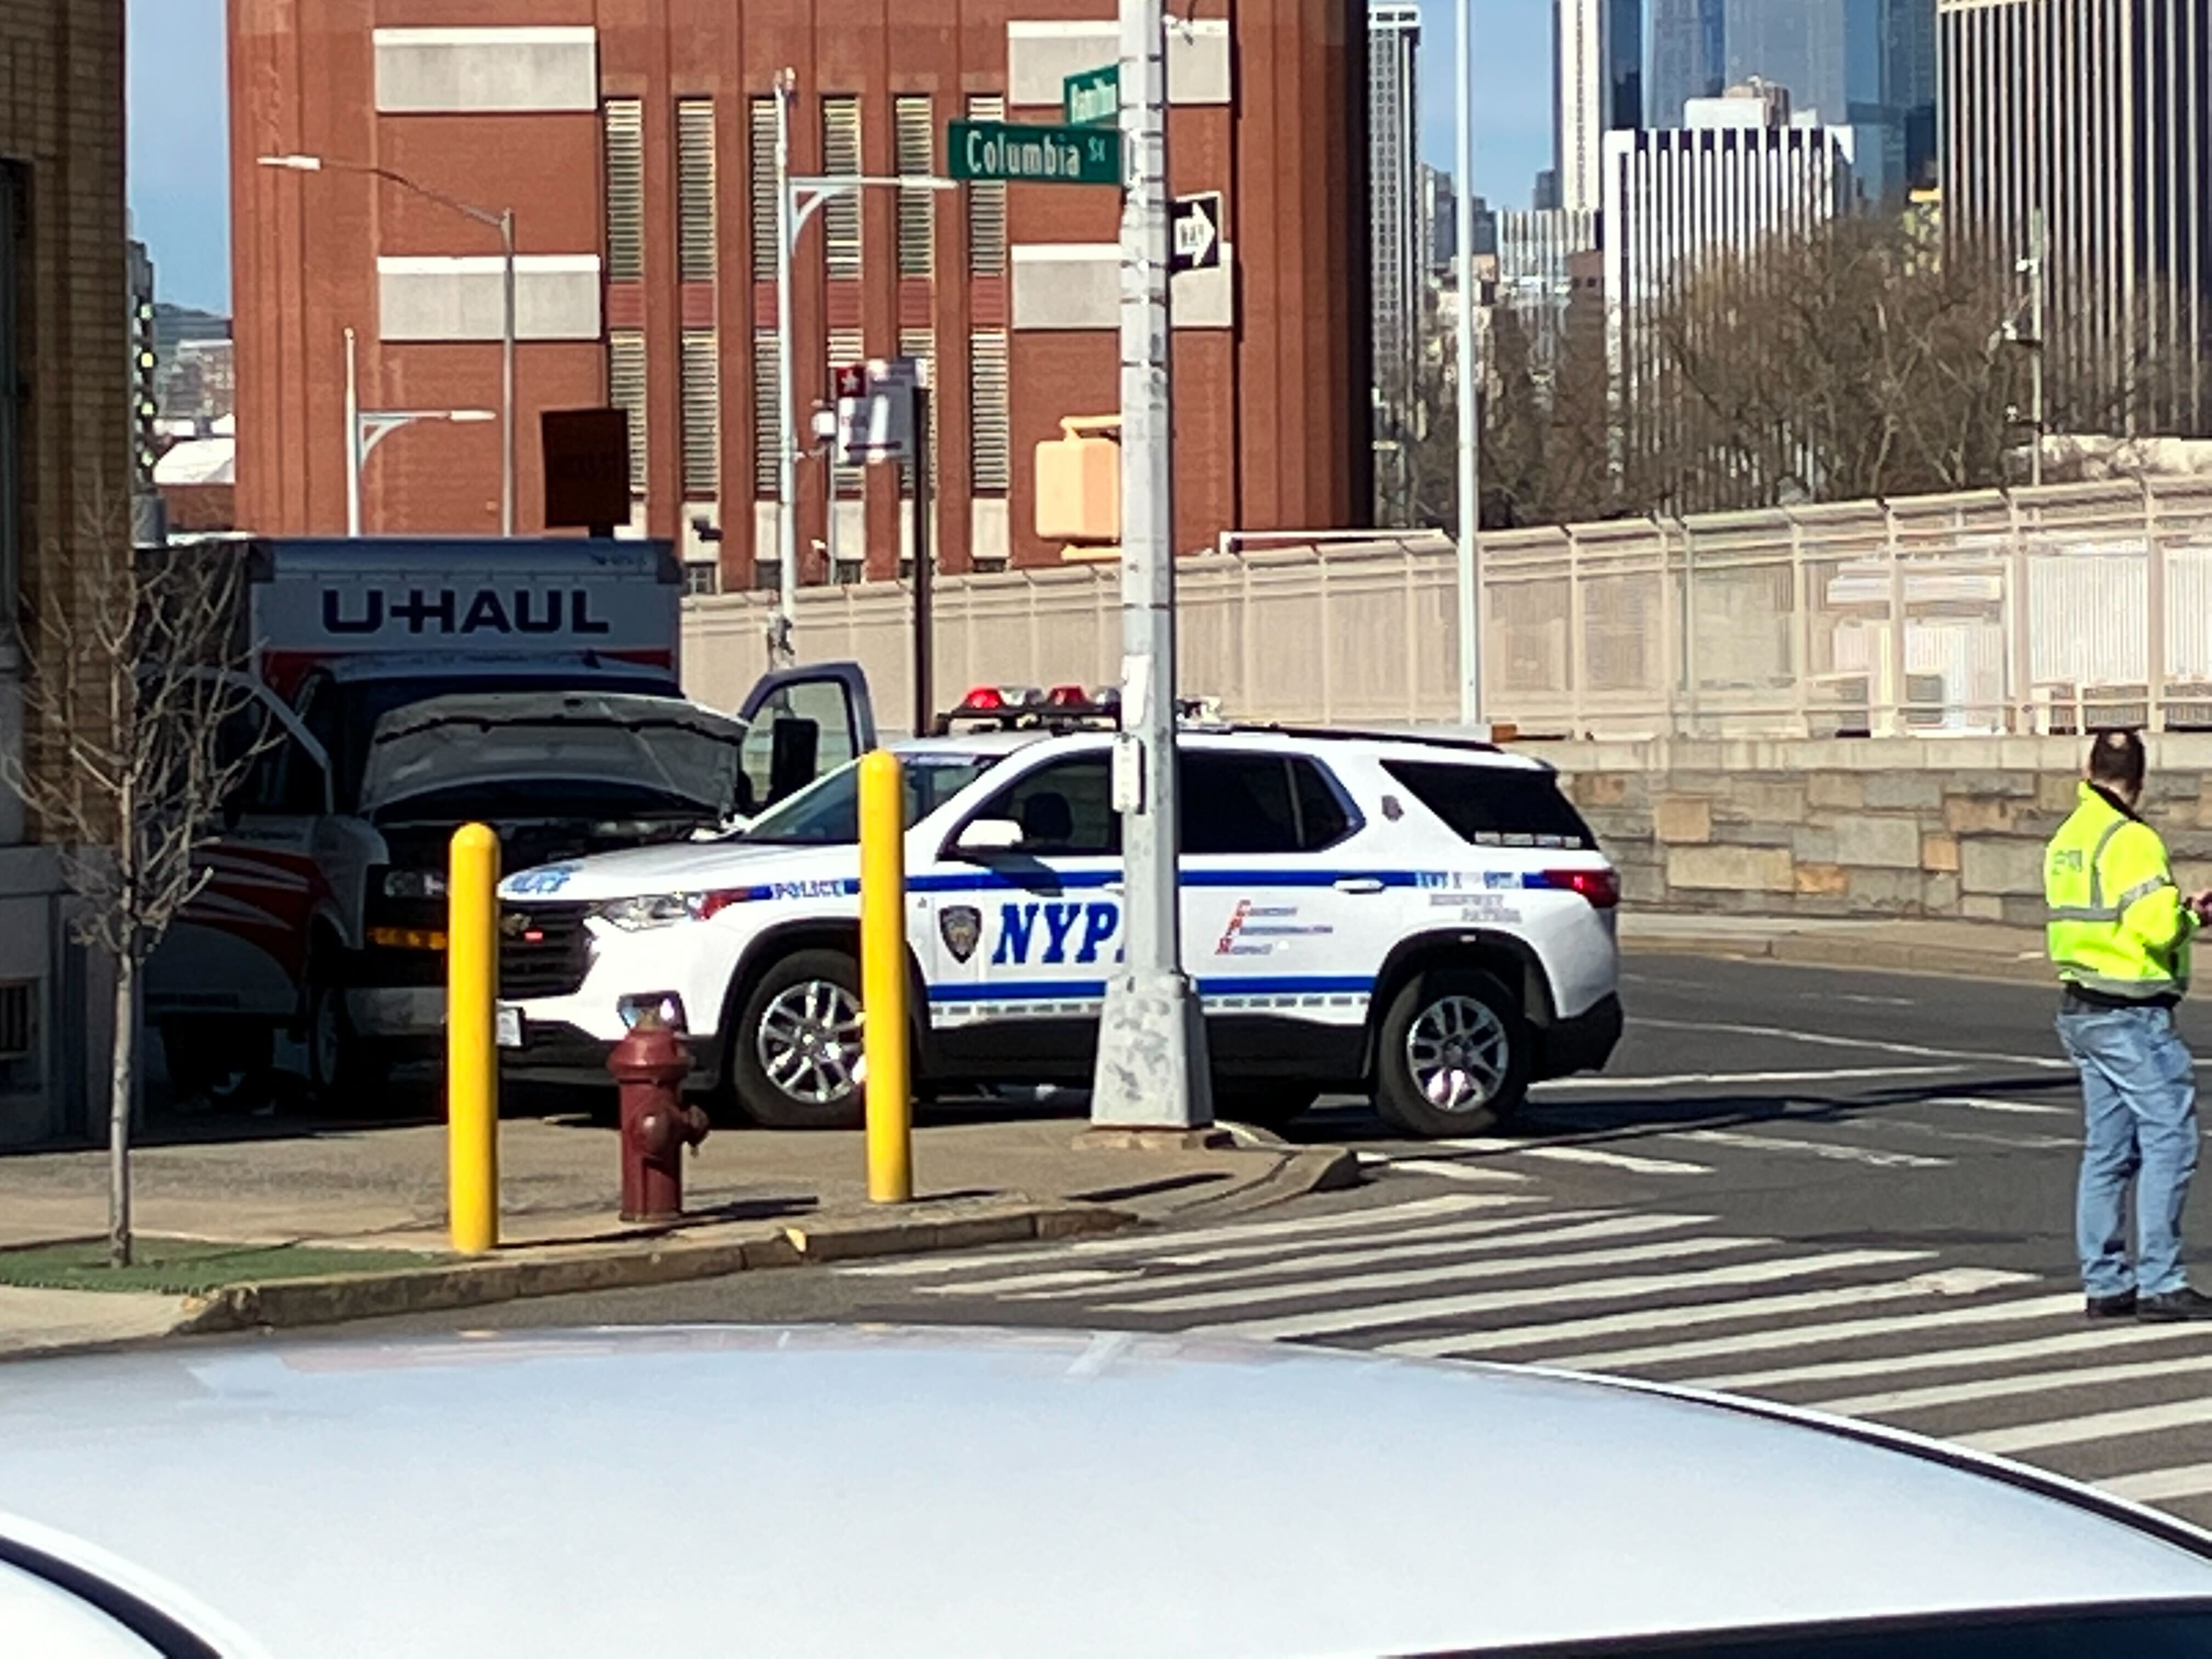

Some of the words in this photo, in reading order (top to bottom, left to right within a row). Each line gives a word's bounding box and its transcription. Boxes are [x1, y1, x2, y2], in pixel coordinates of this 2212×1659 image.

[967, 129, 1081, 177] Columbia
[772, 881, 843, 900] POLICE
[991, 902, 1125, 964] NYP
